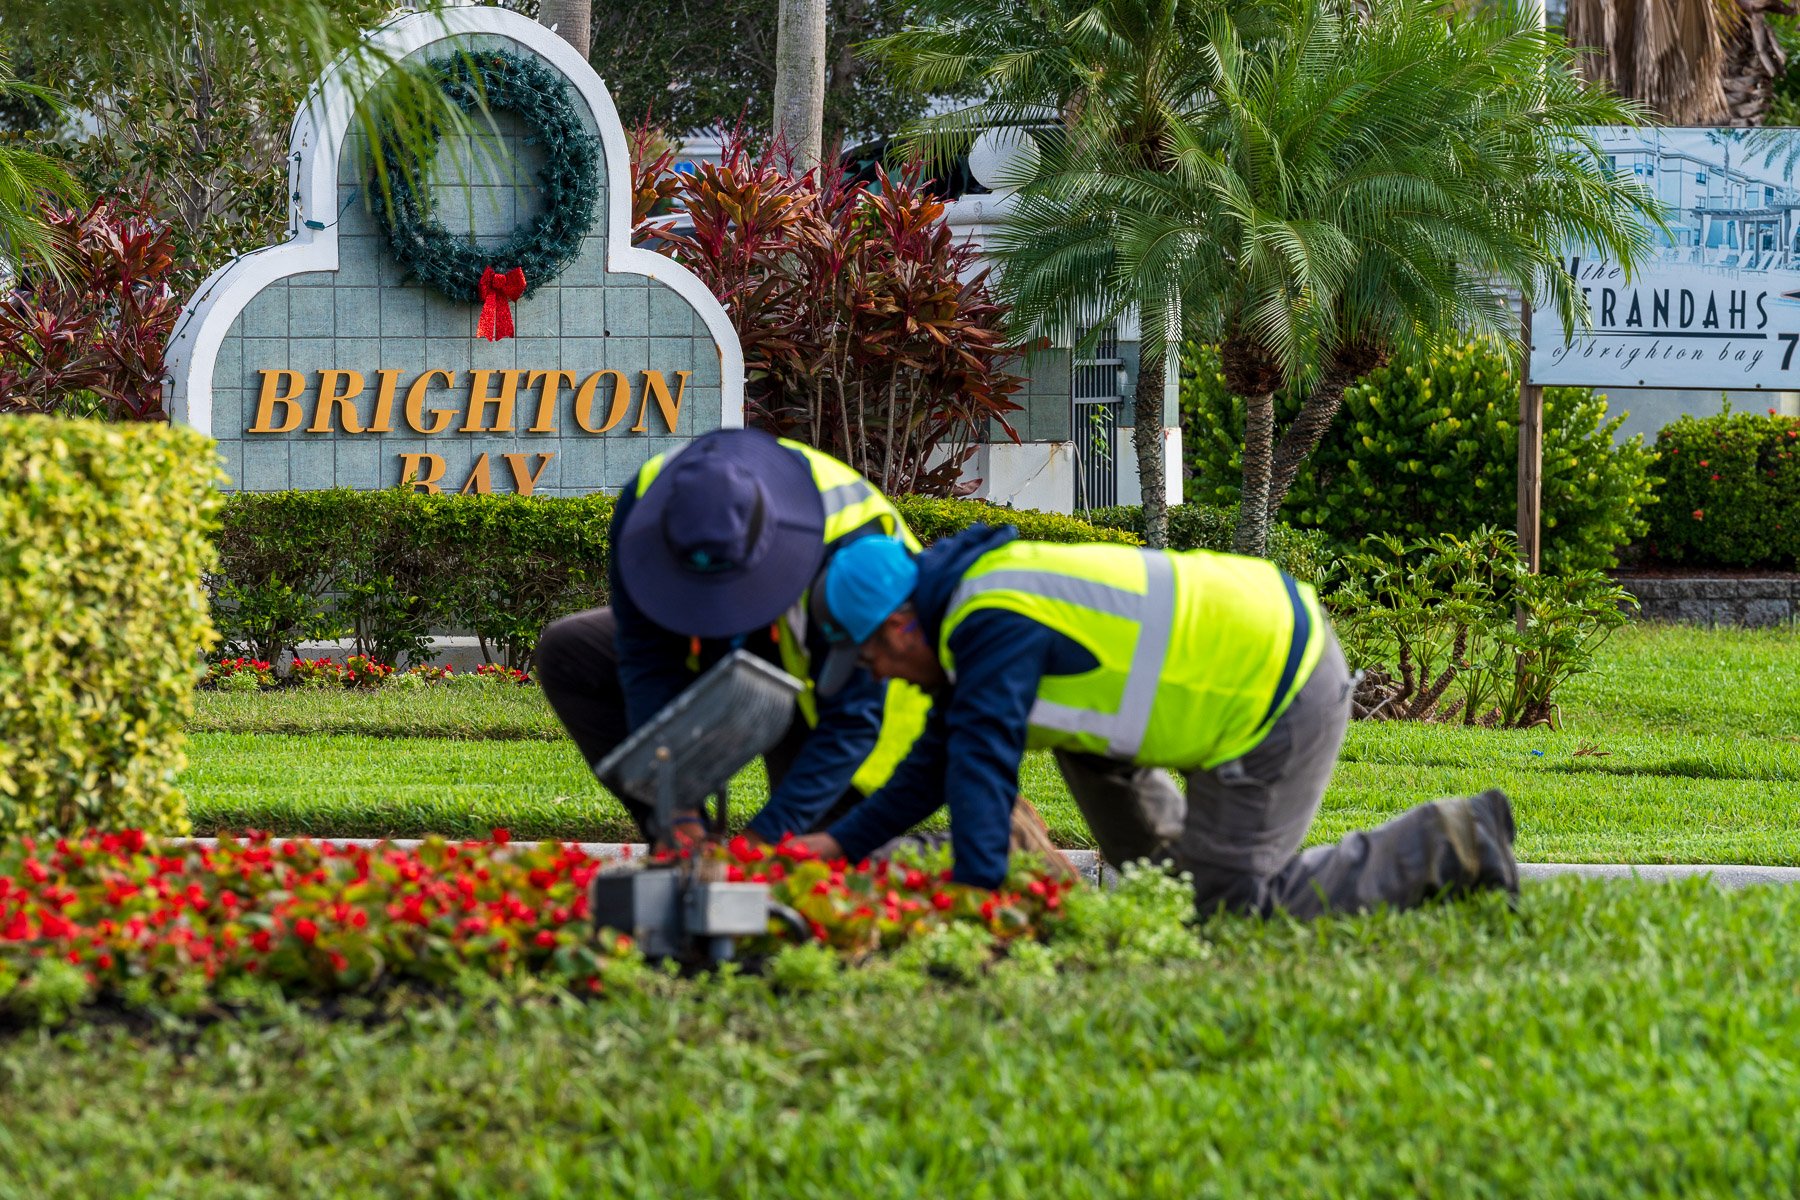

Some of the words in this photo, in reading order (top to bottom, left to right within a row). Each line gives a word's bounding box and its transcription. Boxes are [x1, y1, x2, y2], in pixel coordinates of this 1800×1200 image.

[1581, 258, 1621, 280] the
[1552, 338, 1580, 367] of
[1583, 339, 1704, 370] brighton
[1719, 341, 1764, 373] bay
[1778, 333, 1800, 370] 7
[248, 369, 692, 433] BRIGHTON
[399, 452, 555, 496] BAY
